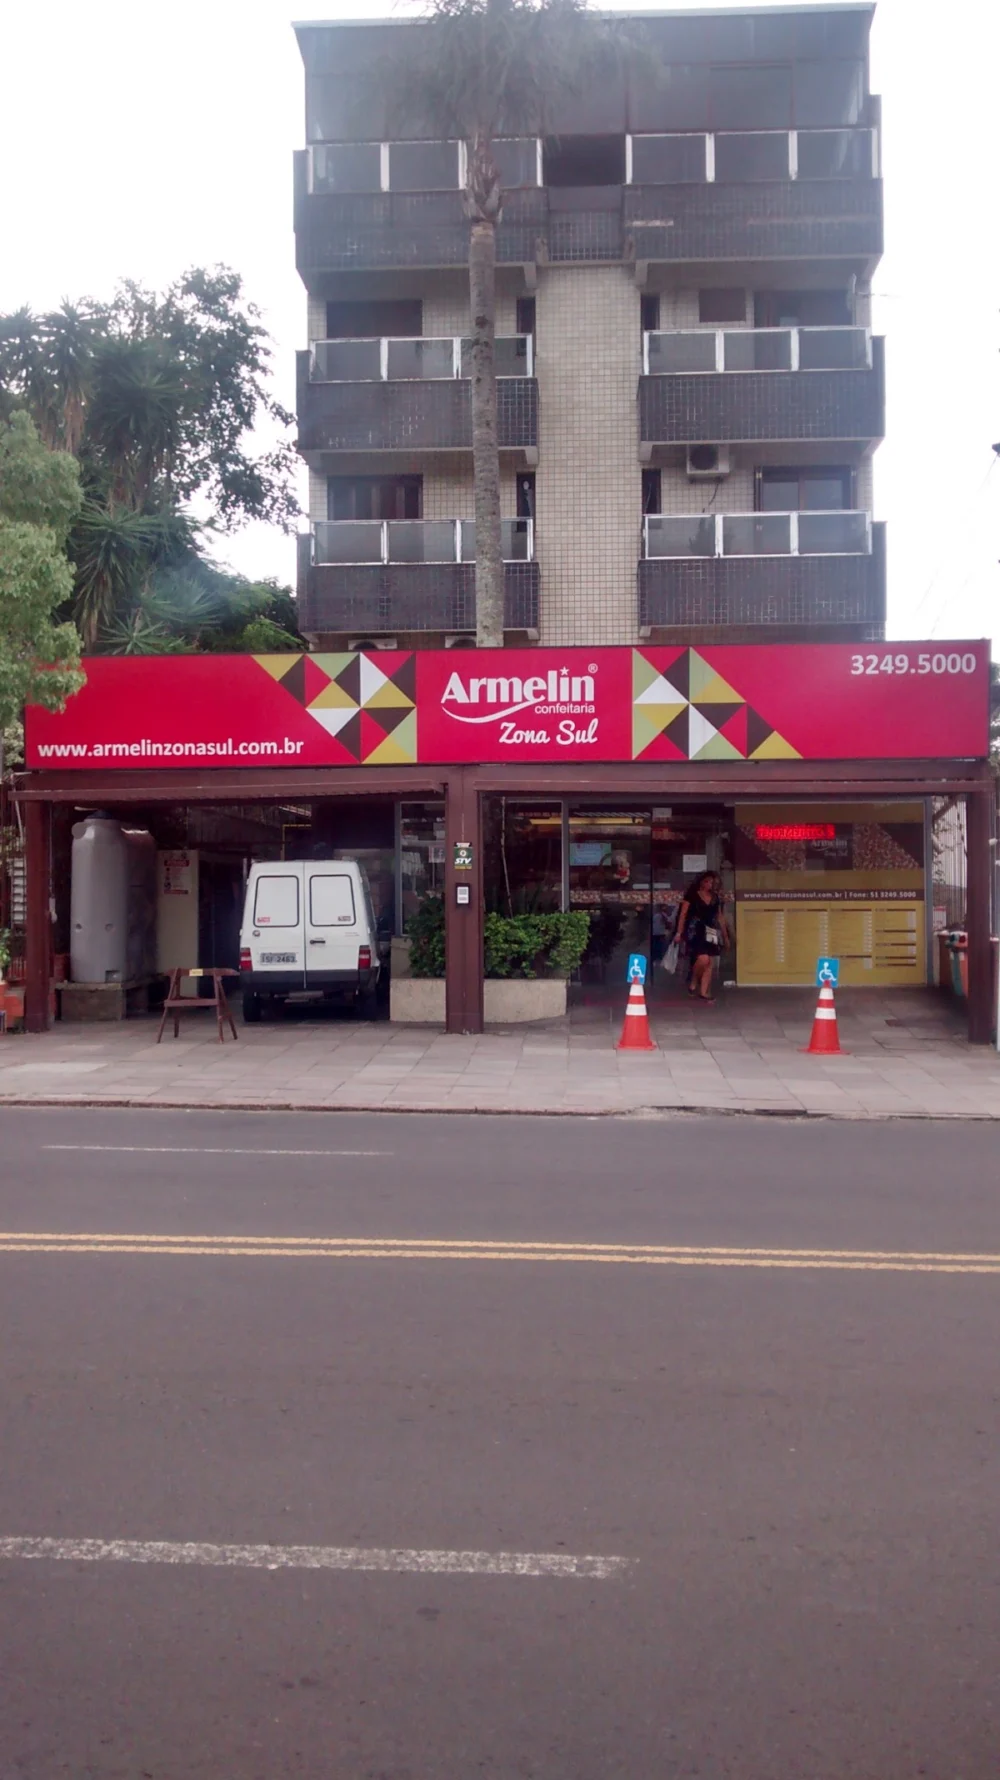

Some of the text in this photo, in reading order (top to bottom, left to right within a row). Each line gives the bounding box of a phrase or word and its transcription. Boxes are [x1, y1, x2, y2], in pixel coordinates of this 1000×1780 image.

[850, 653, 977, 675] 3249.5000
[440, 666, 596, 704] Armelin
[534, 702, 596, 714] confeitaria
[498, 717, 599, 745] Zona Sul
[37, 738, 304, 758] www.armelinzonasul.com.br
[454, 857, 472, 865] STV
